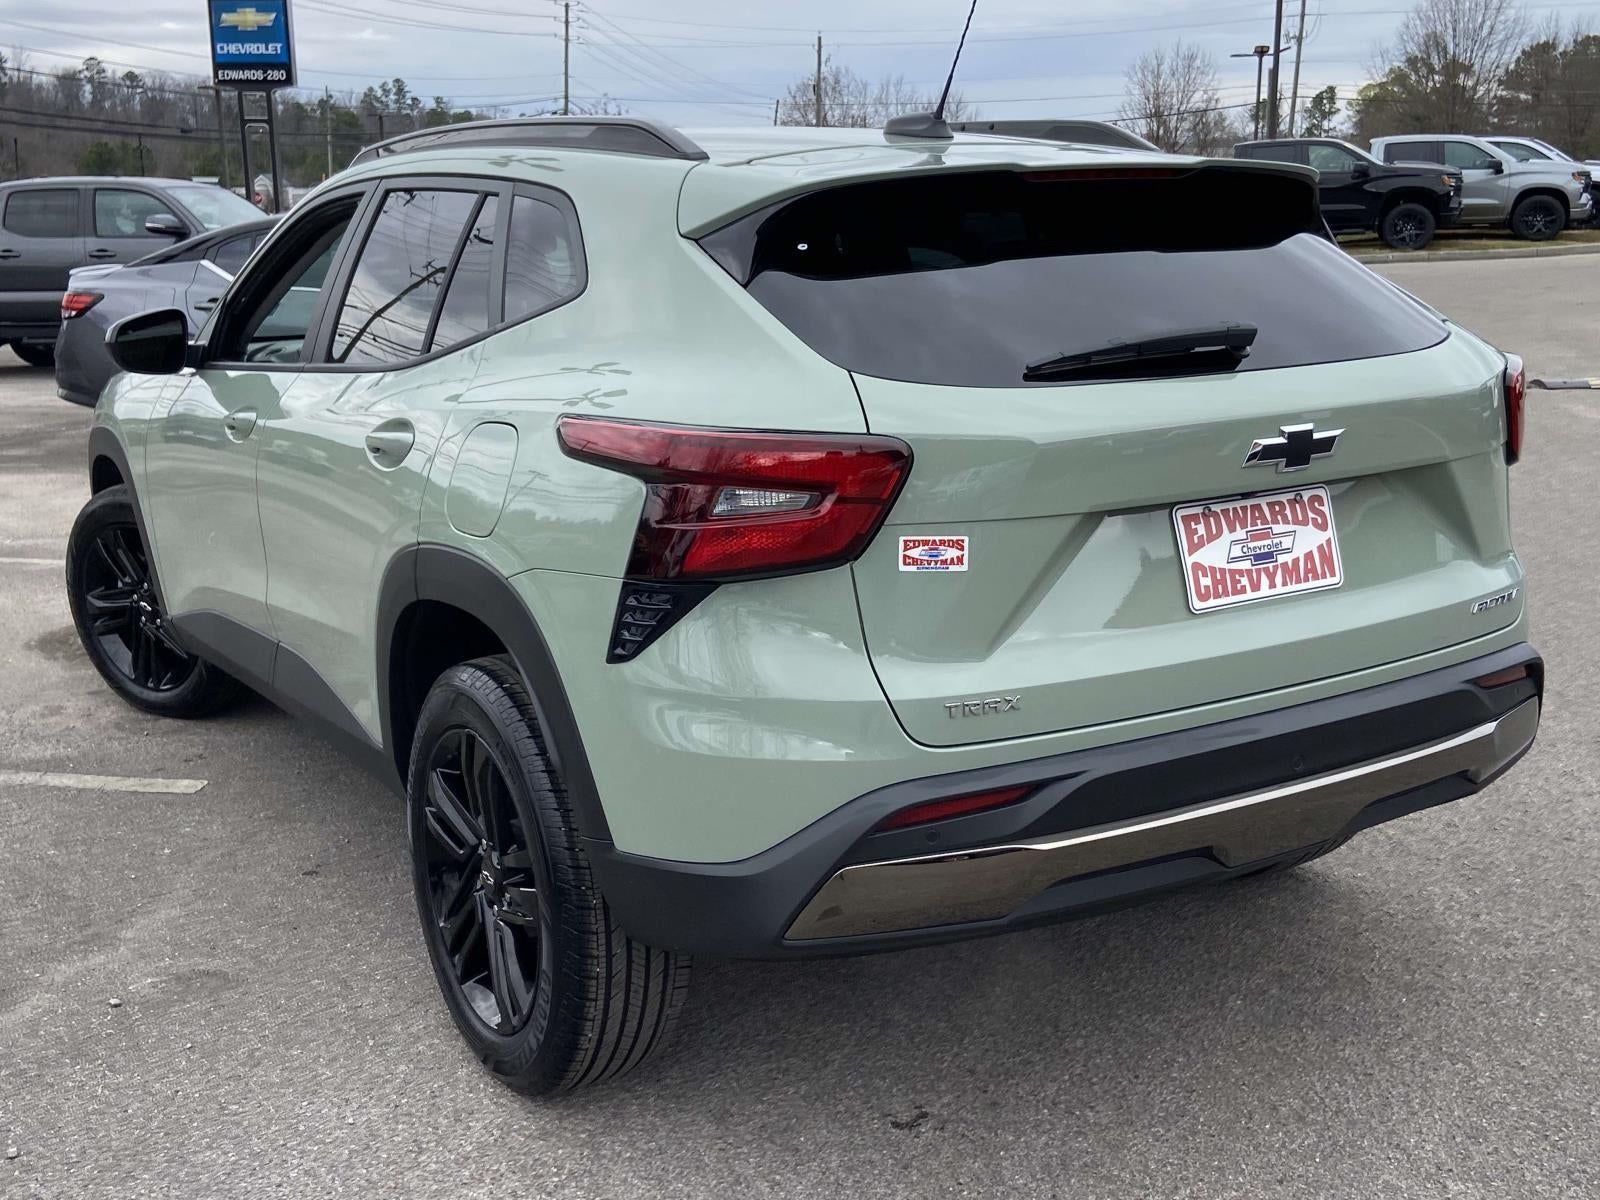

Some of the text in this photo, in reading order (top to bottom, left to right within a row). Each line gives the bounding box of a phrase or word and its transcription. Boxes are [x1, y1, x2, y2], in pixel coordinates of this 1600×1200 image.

[217, 43, 283, 54] CHEVROLET
[218, 70, 286, 80] EDWARDS-280
[1181, 494, 1329, 557] EDWARDS
[903, 539, 965, 552] EDWARDS
[1241, 540, 1283, 555] Chevrolet
[903, 554, 964, 566] CHEVYMAN
[1191, 537, 1336, 603] CHEVYMAN
[944, 695, 1020, 719] TRAX
